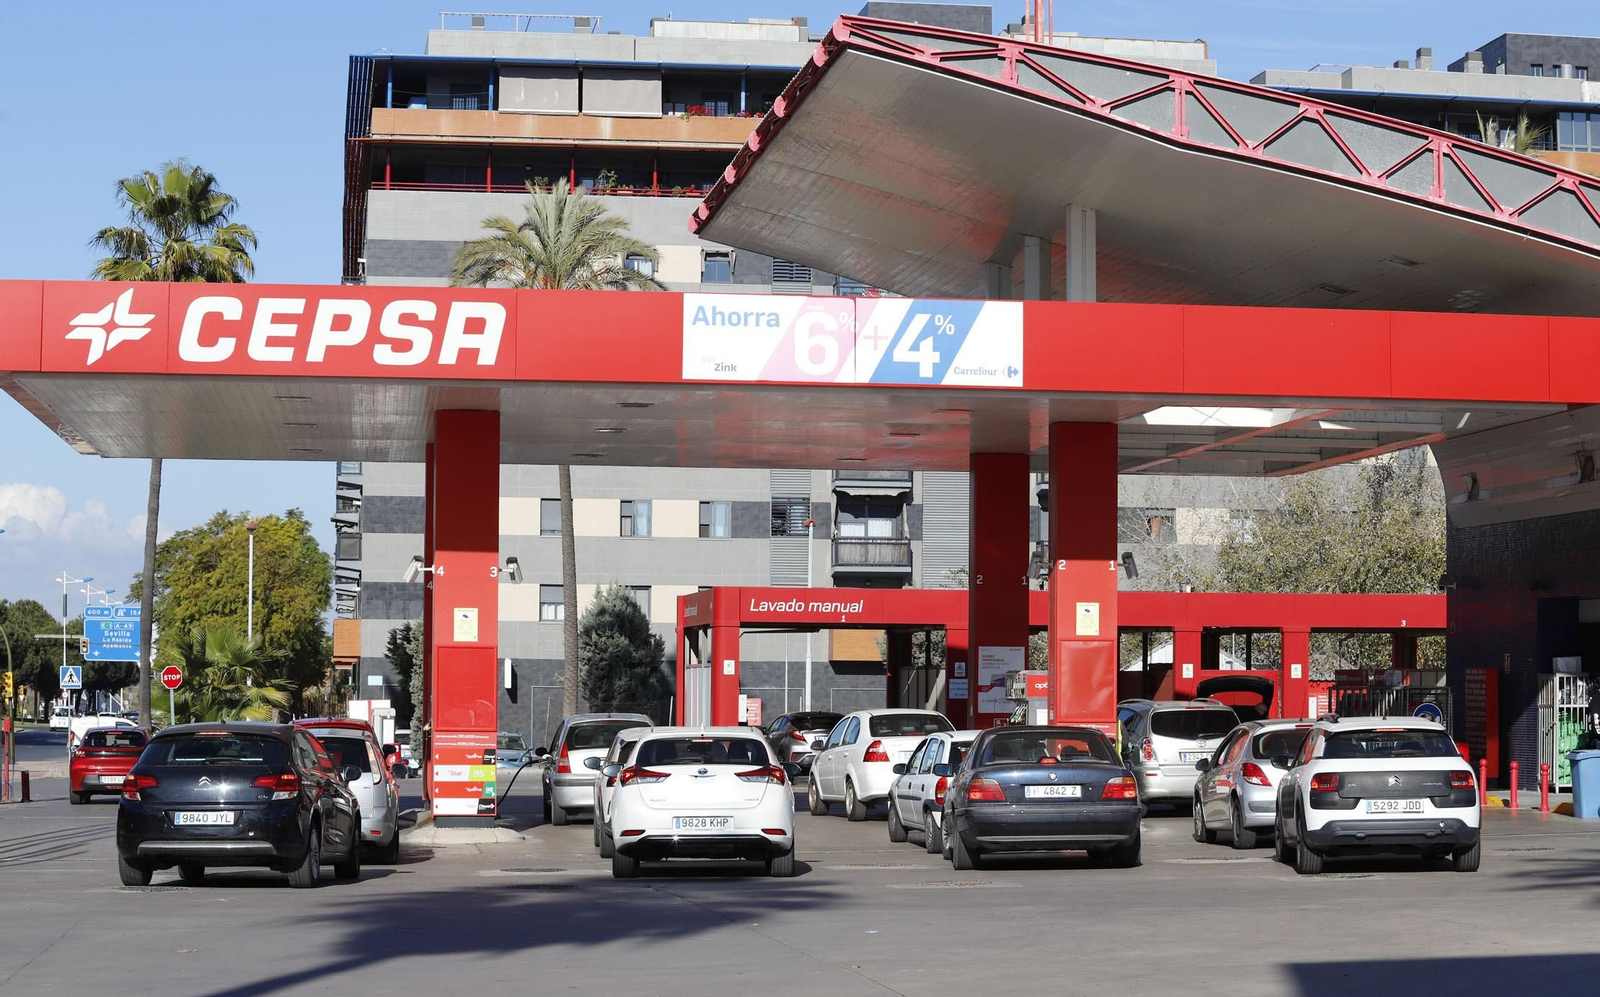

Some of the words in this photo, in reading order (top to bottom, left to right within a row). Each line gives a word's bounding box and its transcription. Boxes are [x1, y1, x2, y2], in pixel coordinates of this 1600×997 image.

[692, 305, 780, 328] Ahorra
[178, 296, 507, 366] CEPSA
[893, 313, 955, 378] 4%
[714, 362, 737, 372] Zink
[953, 366, 998, 378] Carrefour
[1058, 559, 1066, 570] 2
[1109, 560, 1116, 571] 1
[436, 566, 445, 576] 4
[490, 567, 498, 577] 3
[976, 575, 983, 585] 2
[1021, 576, 1028, 585] 1
[750, 598, 805, 612] Lavado
[808, 599, 864, 613] manual
[1400, 619, 1406, 627] 3
[1044, 786, 1067, 796] 4842
[1071, 786, 1077, 796] Z
[1373, 800, 1399, 811] 5292
[1403, 800, 1421, 811] JDD
[182, 813, 208, 823] 9840
[213, 813, 231, 823] JYL
[681, 817, 707, 828] 9828
[709, 817, 729, 828] KHP
